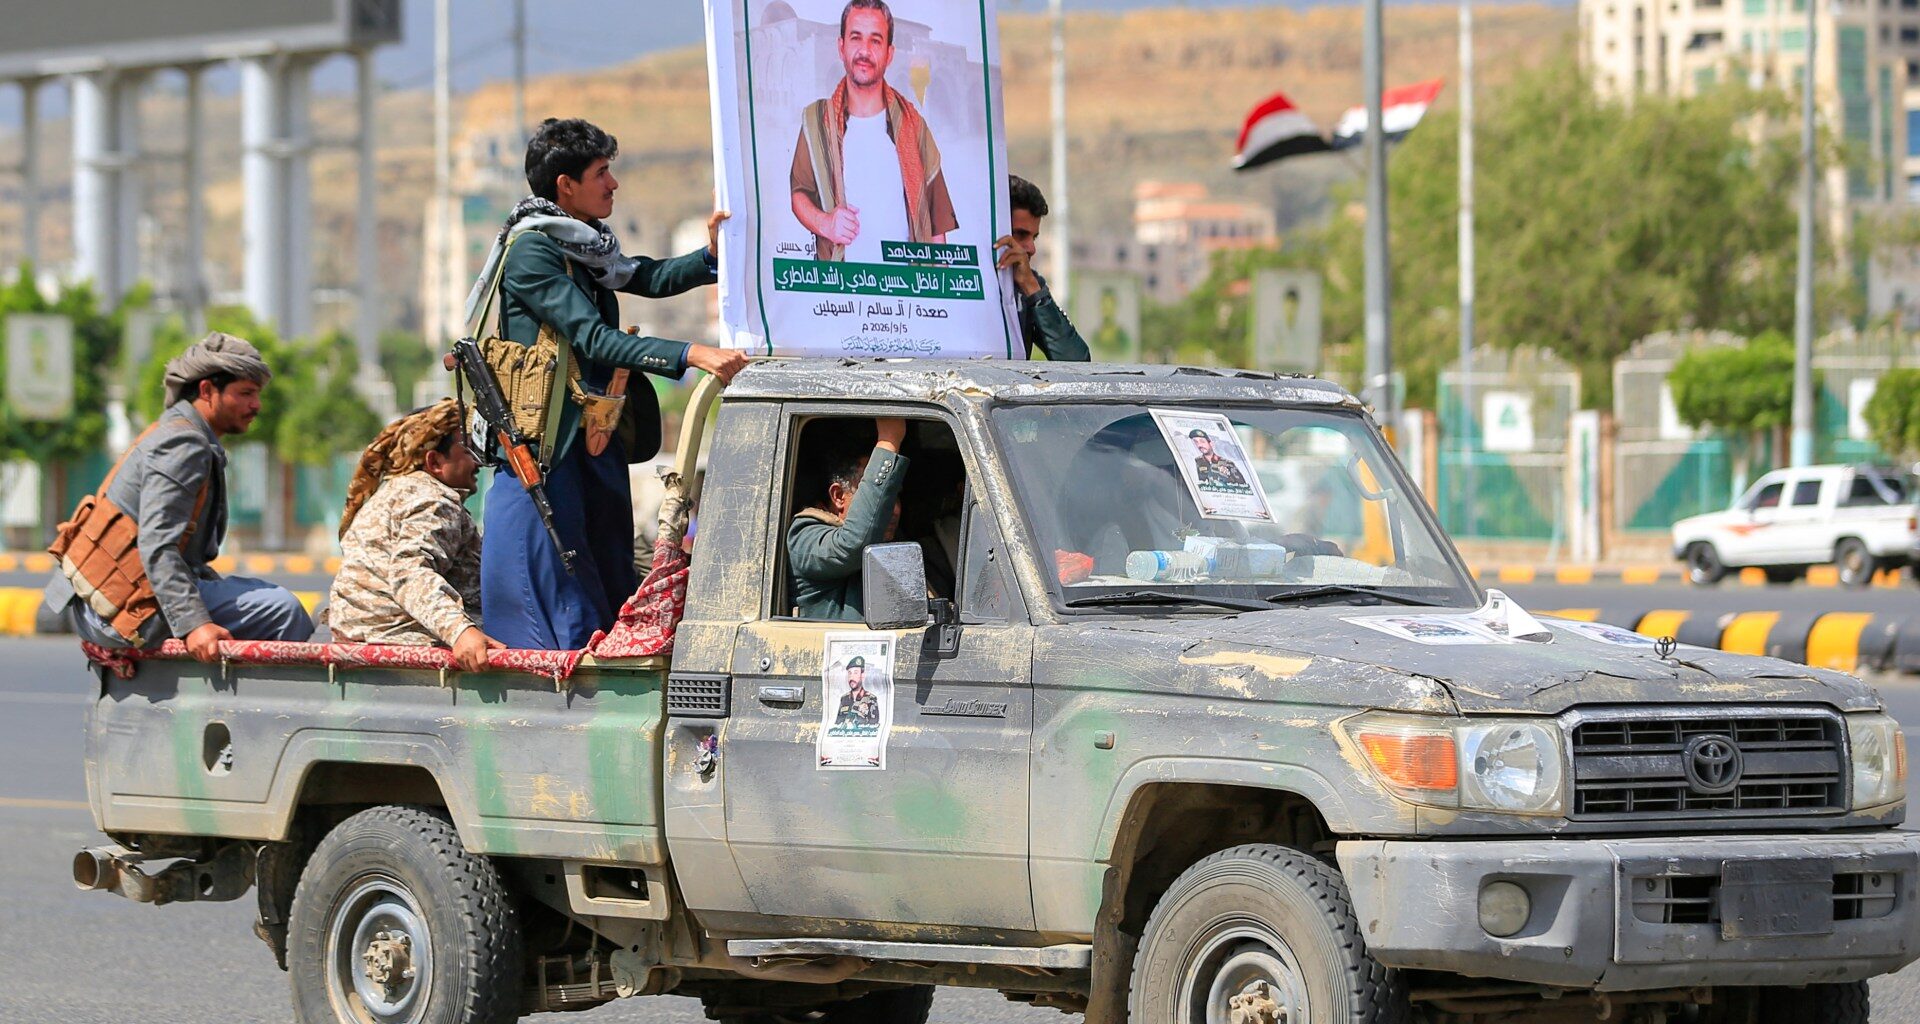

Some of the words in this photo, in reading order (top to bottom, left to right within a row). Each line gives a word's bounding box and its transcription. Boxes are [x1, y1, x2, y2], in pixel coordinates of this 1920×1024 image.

[776, 241, 802, 254] حسين
[805, 236, 816, 256] أبو
[887, 244, 931, 262] المجاهد
[934, 245, 970, 264] الشهيد
[776, 265, 819, 289] الماطري
[822, 266, 844, 290] راشد
[846, 269, 877, 292] هادي
[879, 275, 909, 292] حسين
[911, 271, 939, 293] فاظل
[949, 274, 980, 296] العقيد
[813, 300, 855, 316] السهلين
[867, 302, 893, 318] سالم
[915, 305, 948, 319] صعدة
[870, 321, 908, 335] 2026/9/5
